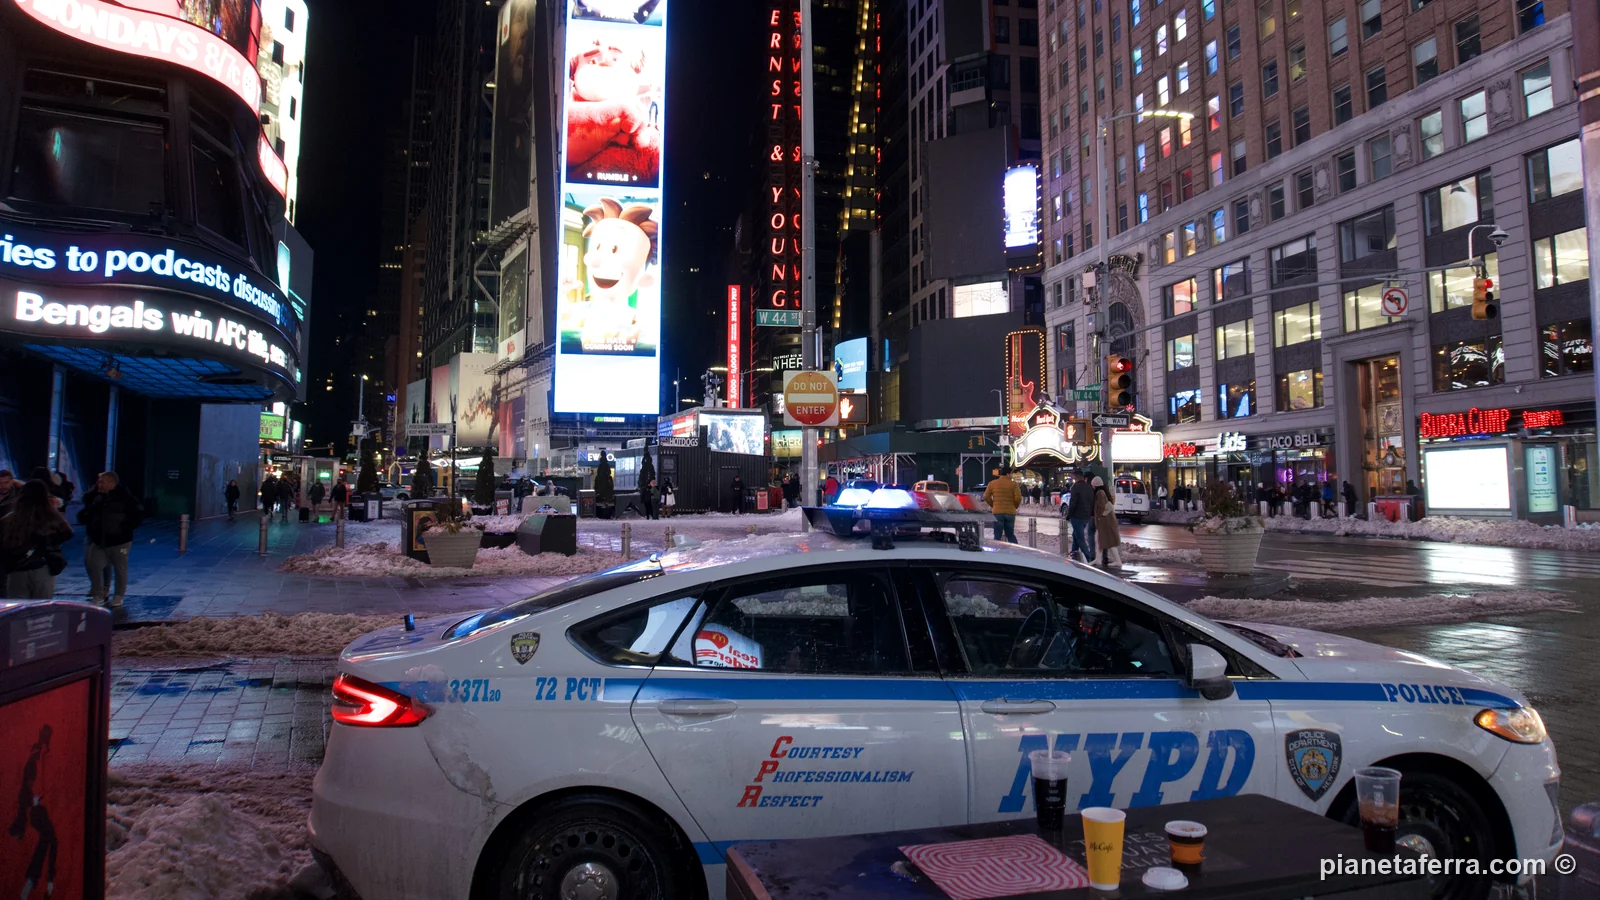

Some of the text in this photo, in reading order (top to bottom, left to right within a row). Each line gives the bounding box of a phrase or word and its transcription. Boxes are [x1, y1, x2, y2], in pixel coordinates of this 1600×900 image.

[769, 9, 785, 307] ERNST & YOUNG
[66, 245, 99, 273] to
[105, 249, 231, 293] podcasts
[233, 273, 281, 325] discussing
[15, 291, 164, 333] Bengals
[171, 311, 213, 340] win
[215, 317, 247, 351] AFC
[759, 311, 798, 324] W 44 ST
[793, 381, 828, 390] DO NOT
[1073, 392, 1081, 400] W
[1083, 392, 1093, 400] 44
[796, 405, 826, 415] ENTER
[1421, 412, 1467, 438] BUBBA
[1468, 406, 1511, 434] GUMP
[1217, 432, 1247, 452] Lids
[1267, 434, 1321, 449] TACO BELL
[578, 449, 600, 462] NEW
[448, 679, 502, 702] 3371 20
[535, 677, 602, 701] 72 PCT
[1382, 683, 1465, 705] POLICE
[1288, 739, 1338, 752] DEPARTMENT
[1298, 731, 1326, 740] POLICE
[769, 735, 865, 760] COURTESY
[753, 760, 915, 783] PROFESSIONALISM
[997, 728, 1257, 813] NYPD
[1288, 758, 1299, 776] CITY
[1322, 774, 1334, 791] NEW
[736, 785, 824, 808] RESPECT
[1072, 832, 1165, 847] TES
